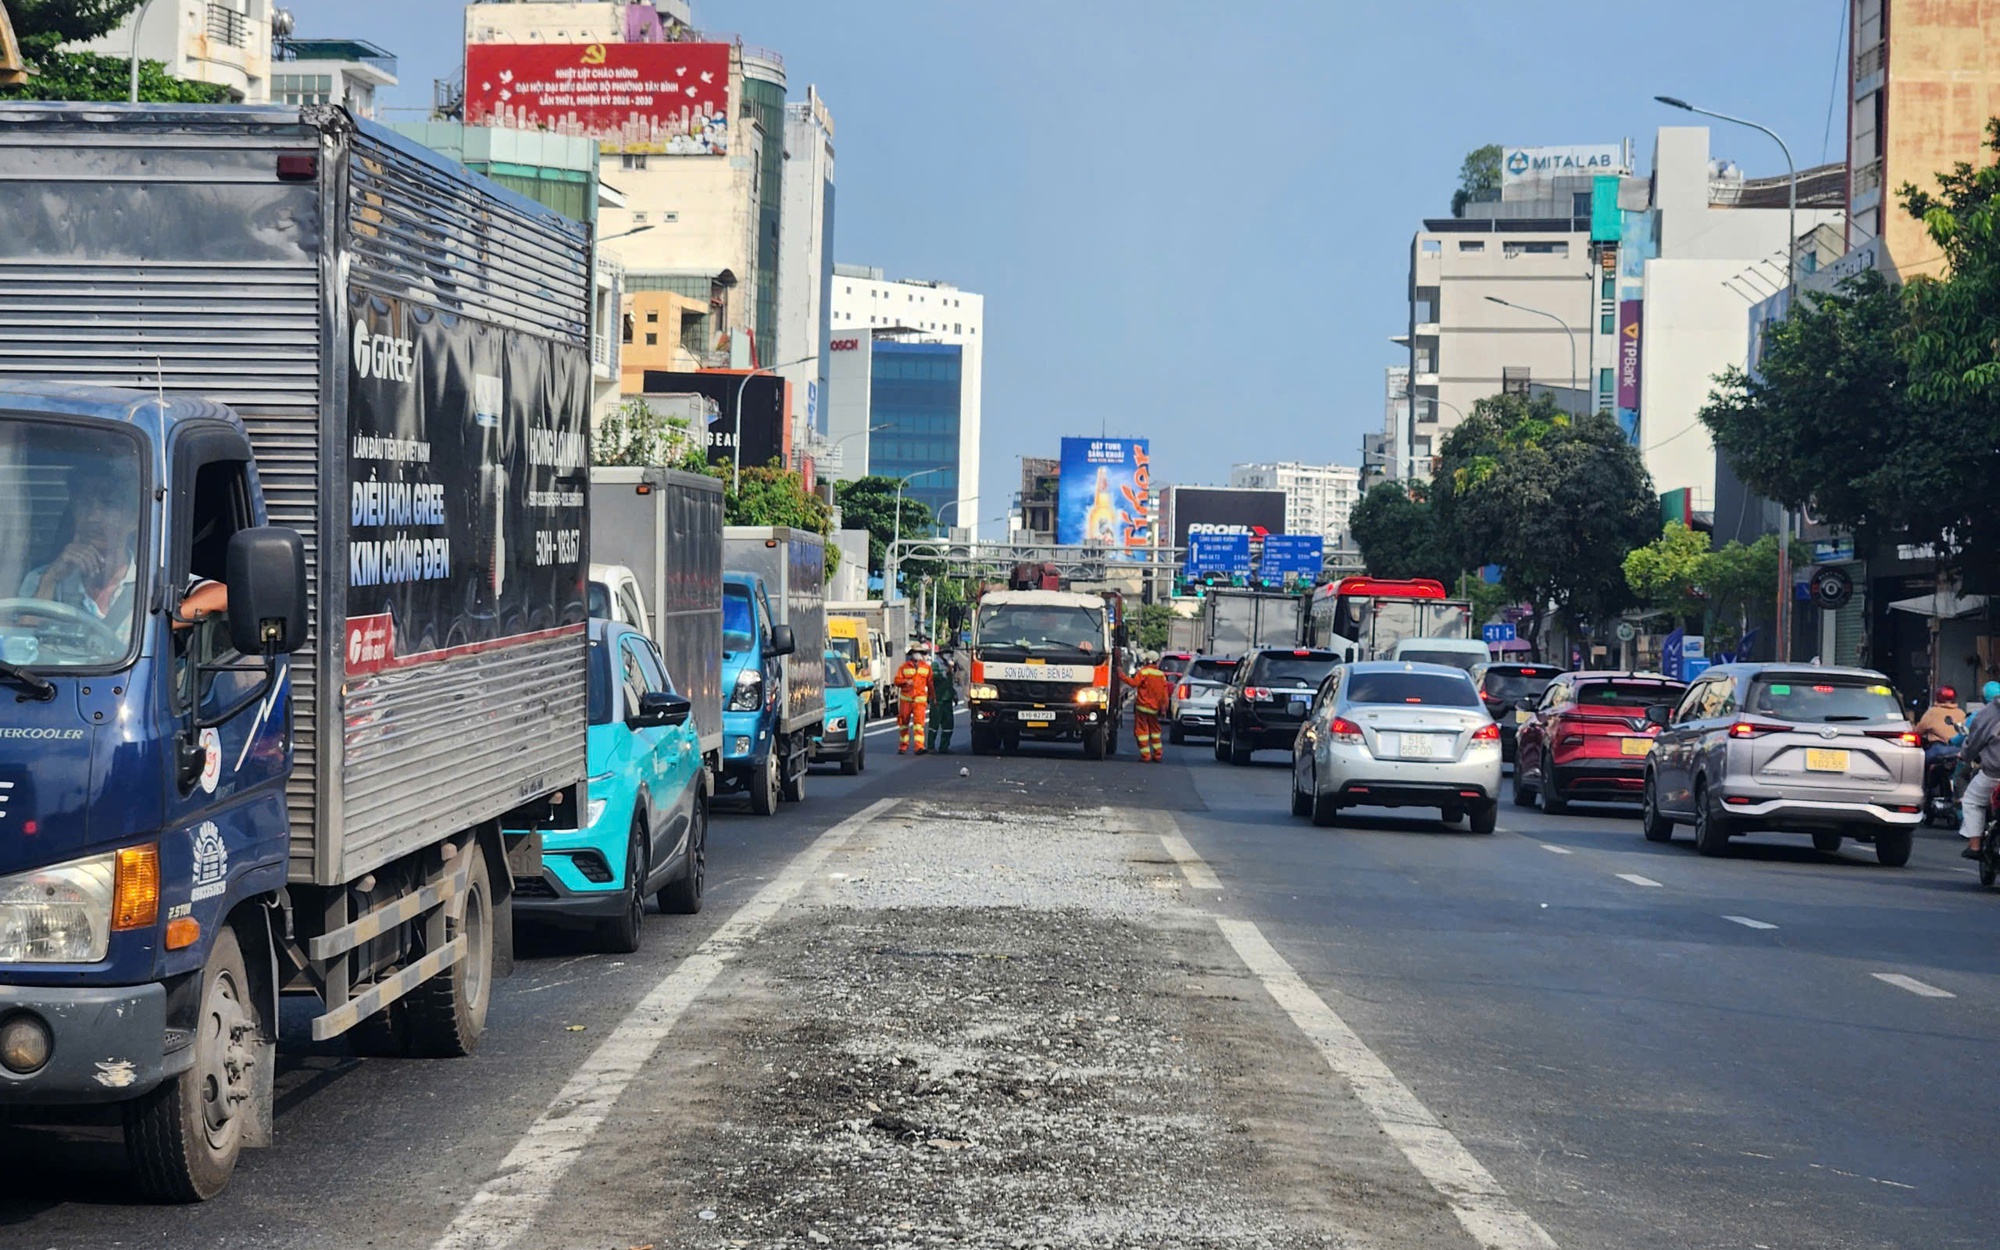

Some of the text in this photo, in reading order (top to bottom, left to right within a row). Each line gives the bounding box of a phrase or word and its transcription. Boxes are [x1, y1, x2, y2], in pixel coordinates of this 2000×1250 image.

[591, 66, 615, 79] CHÀO
[615, 66, 639, 79] MỪNG
[660, 80, 679, 92] BÌNH
[1533, 154, 1611, 170] MITALAB
[372, 334, 413, 383] GREE
[1623, 340, 1638, 387] TPBank
[353, 429, 368, 459] LẦN
[368, 430, 384, 460] ĐẦU
[352, 467, 445, 526] ĐIỀU HÒA GREE
[1188, 523, 1254, 536] PROEL
[350, 531, 450, 586] KIM CƯƠNG ĐEN
[536, 531, 553, 566] 50H
[557, 530, 580, 565] 183.67
[1004, 667, 1017, 678] SƠN
[1017, 666, 1038, 679] ĐƯỜNG
